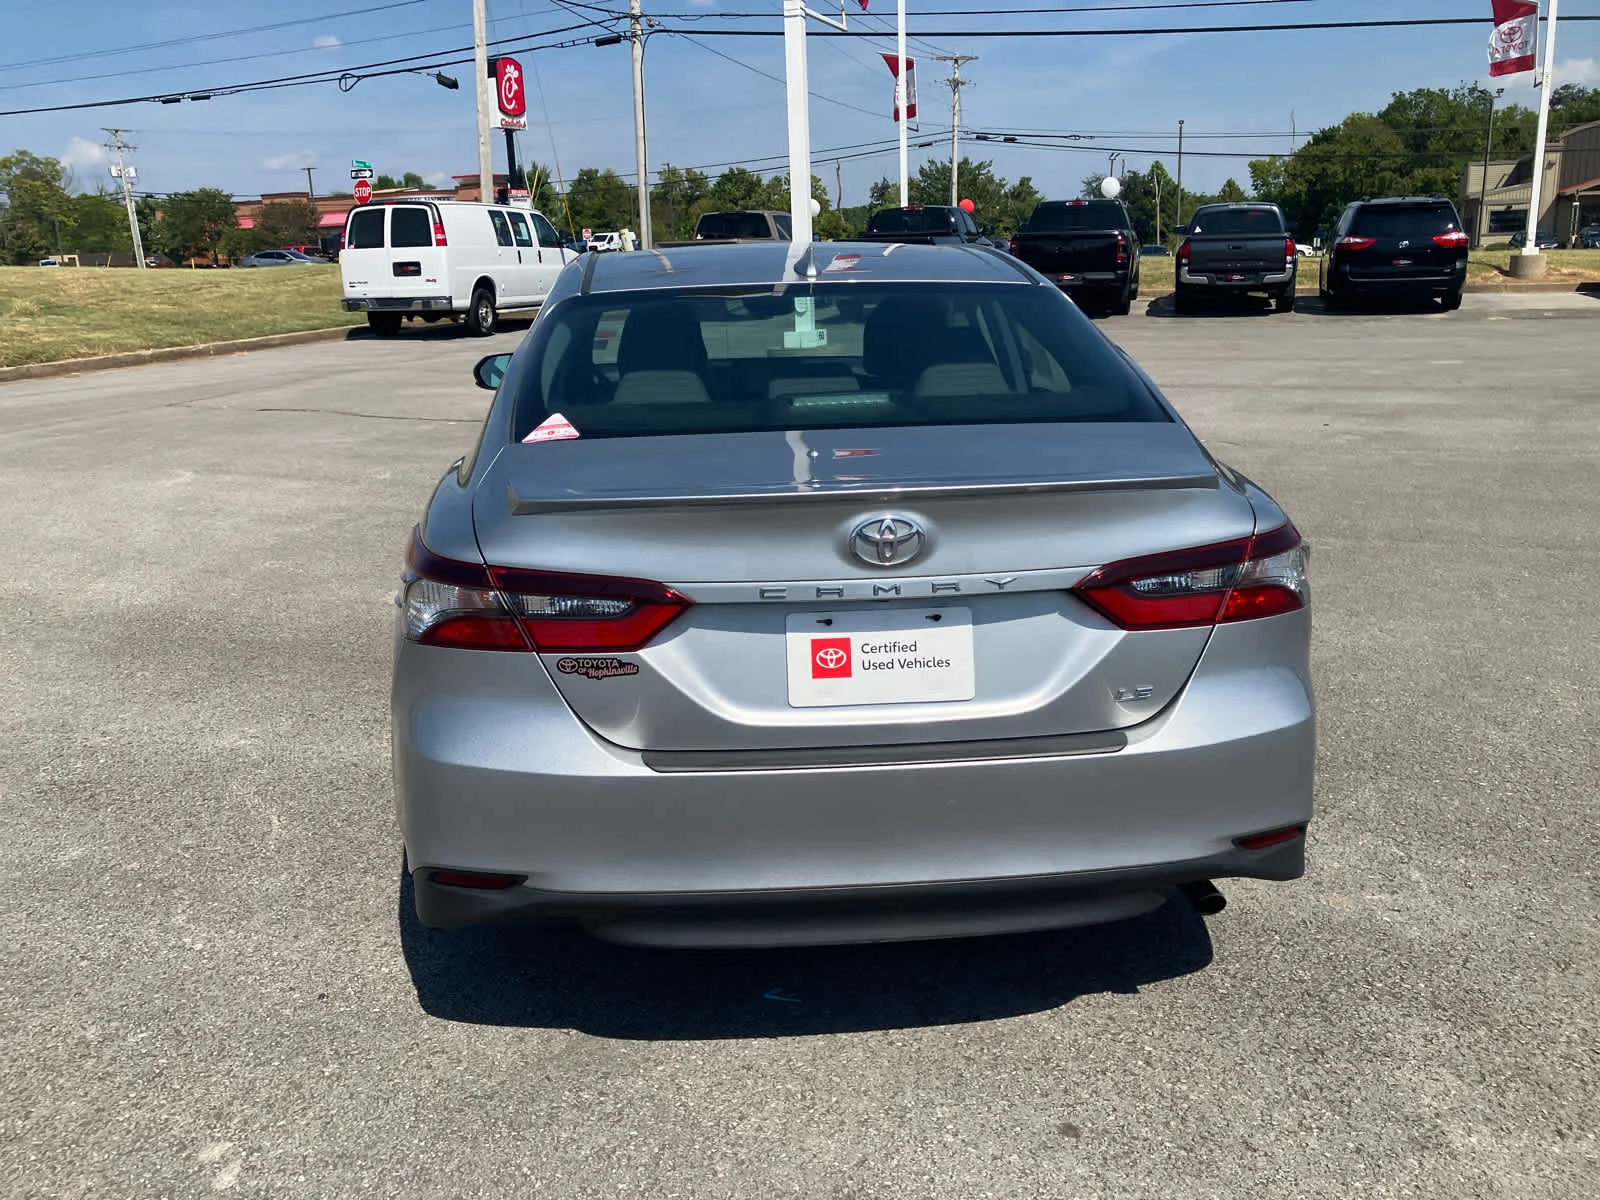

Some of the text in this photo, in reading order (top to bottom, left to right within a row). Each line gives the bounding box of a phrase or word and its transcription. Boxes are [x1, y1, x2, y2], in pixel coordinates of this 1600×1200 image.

[355, 187, 371, 197] STOP
[759, 576, 1018, 599] CAMRY
[861, 640, 918, 654] Certified
[579, 659, 619, 667] TOYOTA
[862, 657, 951, 671] Used Vehicles
